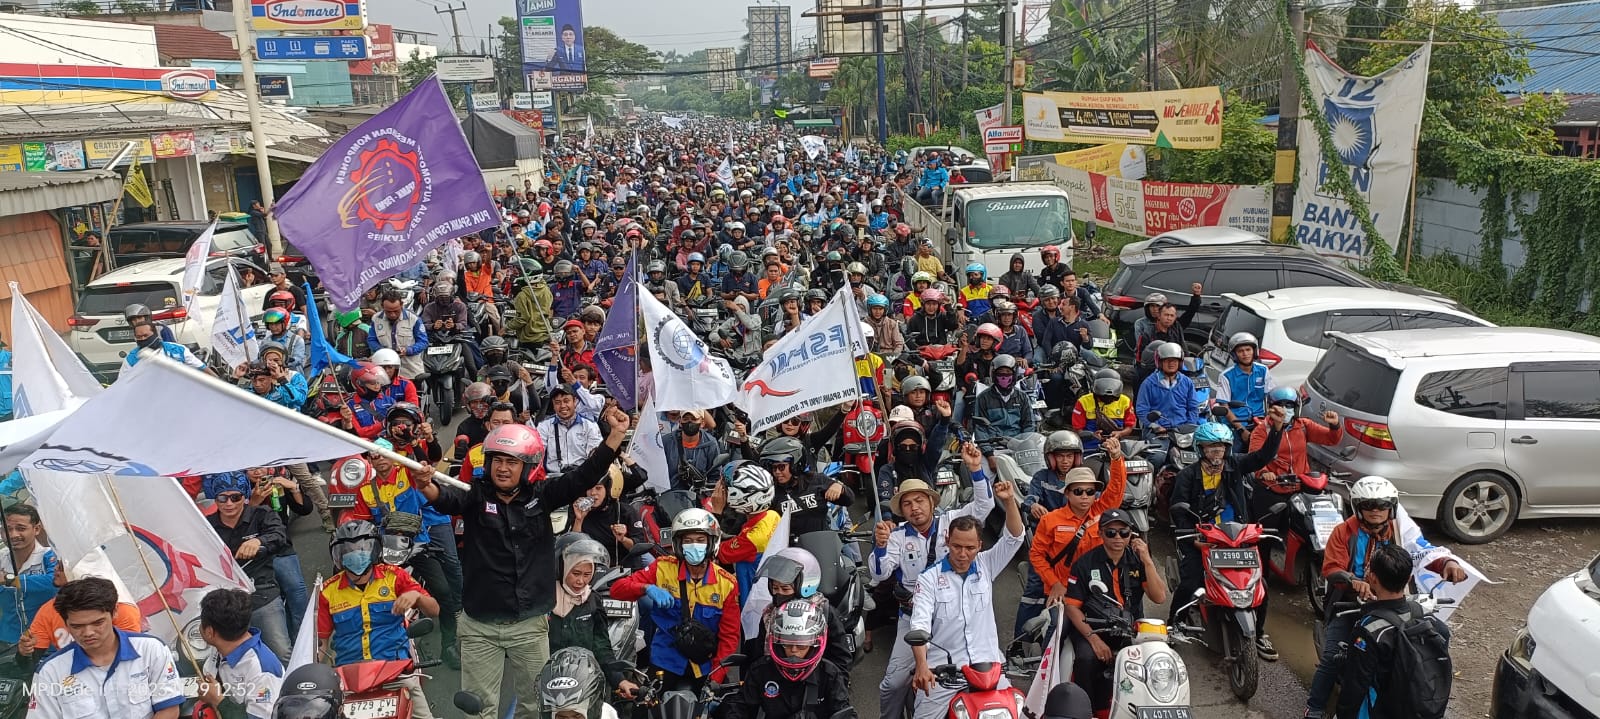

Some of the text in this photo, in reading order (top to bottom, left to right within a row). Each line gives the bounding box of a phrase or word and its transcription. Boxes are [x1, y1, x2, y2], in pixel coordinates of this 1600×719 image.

[271, 3, 340, 17] Indomaret
[172, 79, 207, 91] Indomaret
[1076, 110, 1083, 125] 4
[988, 129, 1020, 137] Alfamart
[93, 141, 118, 149] GRATIS
[1319, 162, 1371, 192] PN
[1144, 182, 1168, 195] Grand
[1169, 183, 1214, 199] Launching
[986, 200, 1050, 212] Bismillah
[1114, 192, 1125, 217] 5
[1145, 210, 1167, 229] 937
[1214, 551, 1220, 559] A
[550, 679, 575, 688] NHC
[350, 701, 374, 712] 6729
[1143, 709, 1149, 719] A
[1153, 709, 1172, 719] 4071
